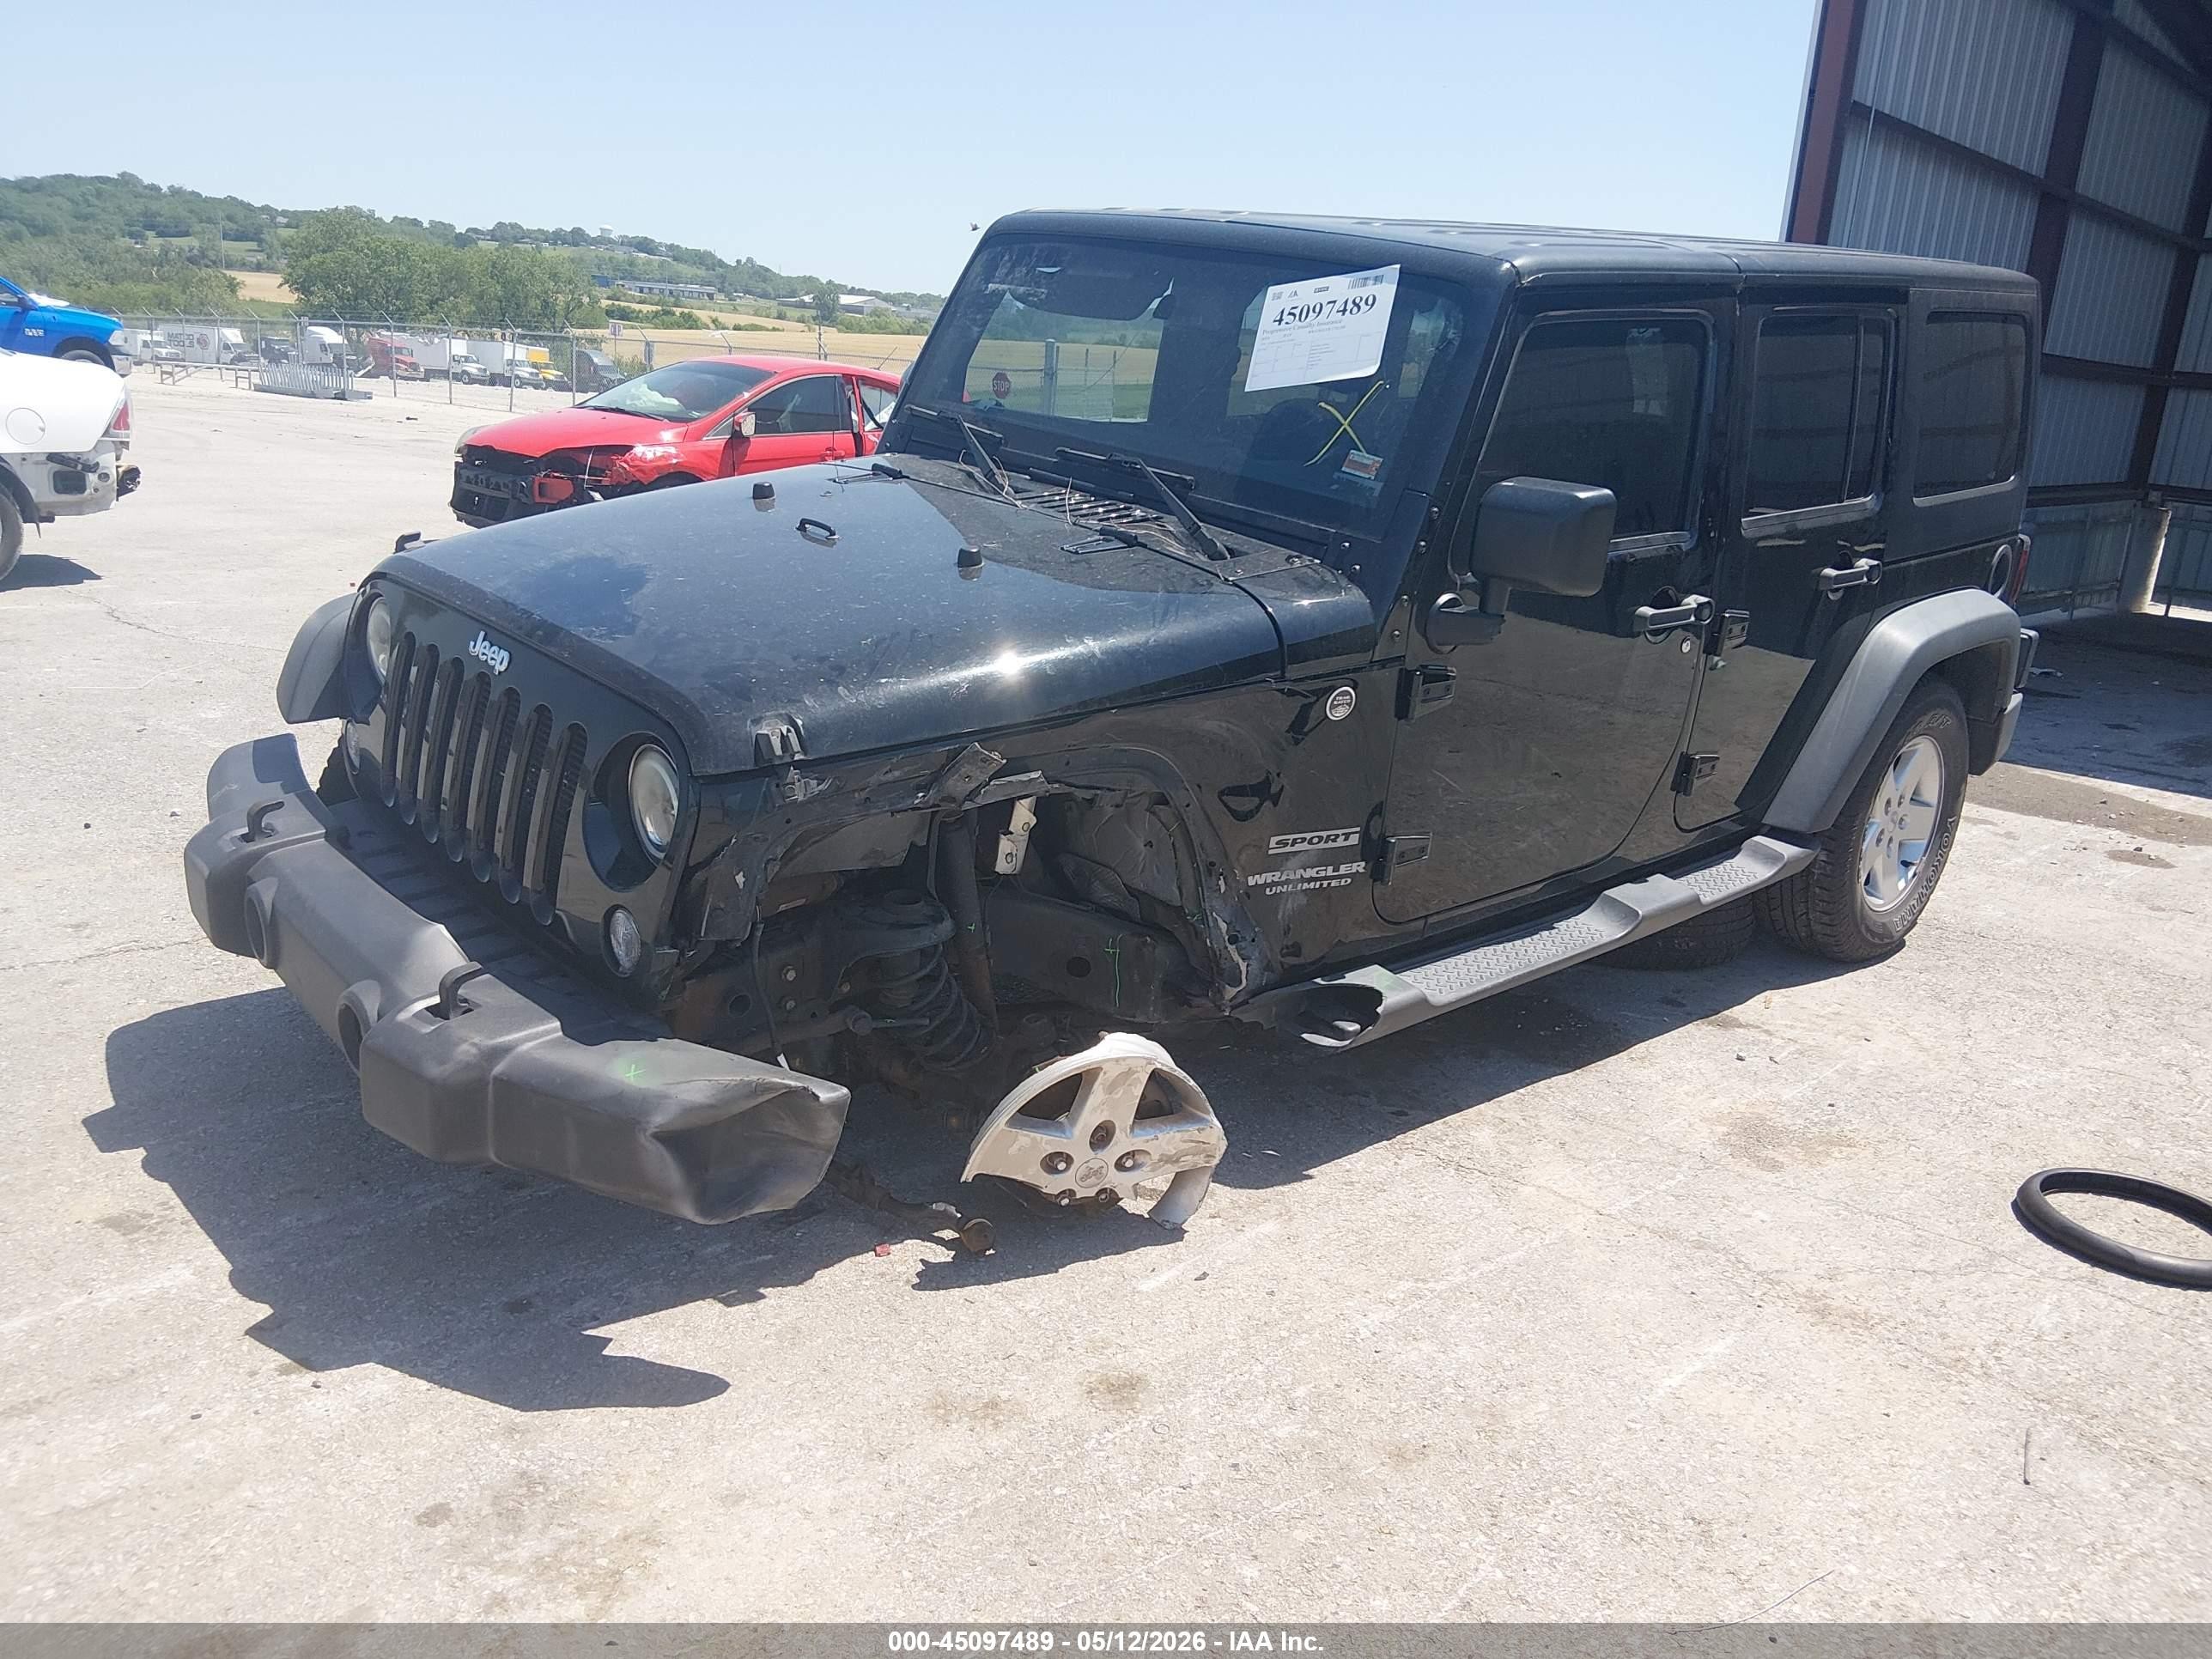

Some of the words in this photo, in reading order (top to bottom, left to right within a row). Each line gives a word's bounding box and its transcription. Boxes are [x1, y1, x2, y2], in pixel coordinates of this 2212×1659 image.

[1273, 294, 1377, 326] 45097489
[993, 380, 1010, 392] STOP
[469, 630, 512, 676] Jeep
[1274, 831, 1359, 848] SPORT
[1248, 861, 1366, 886] WRANGLER
[1893, 815, 1958, 931] YOKOHAMA
[1265, 878, 1352, 896] UNLIMITED
